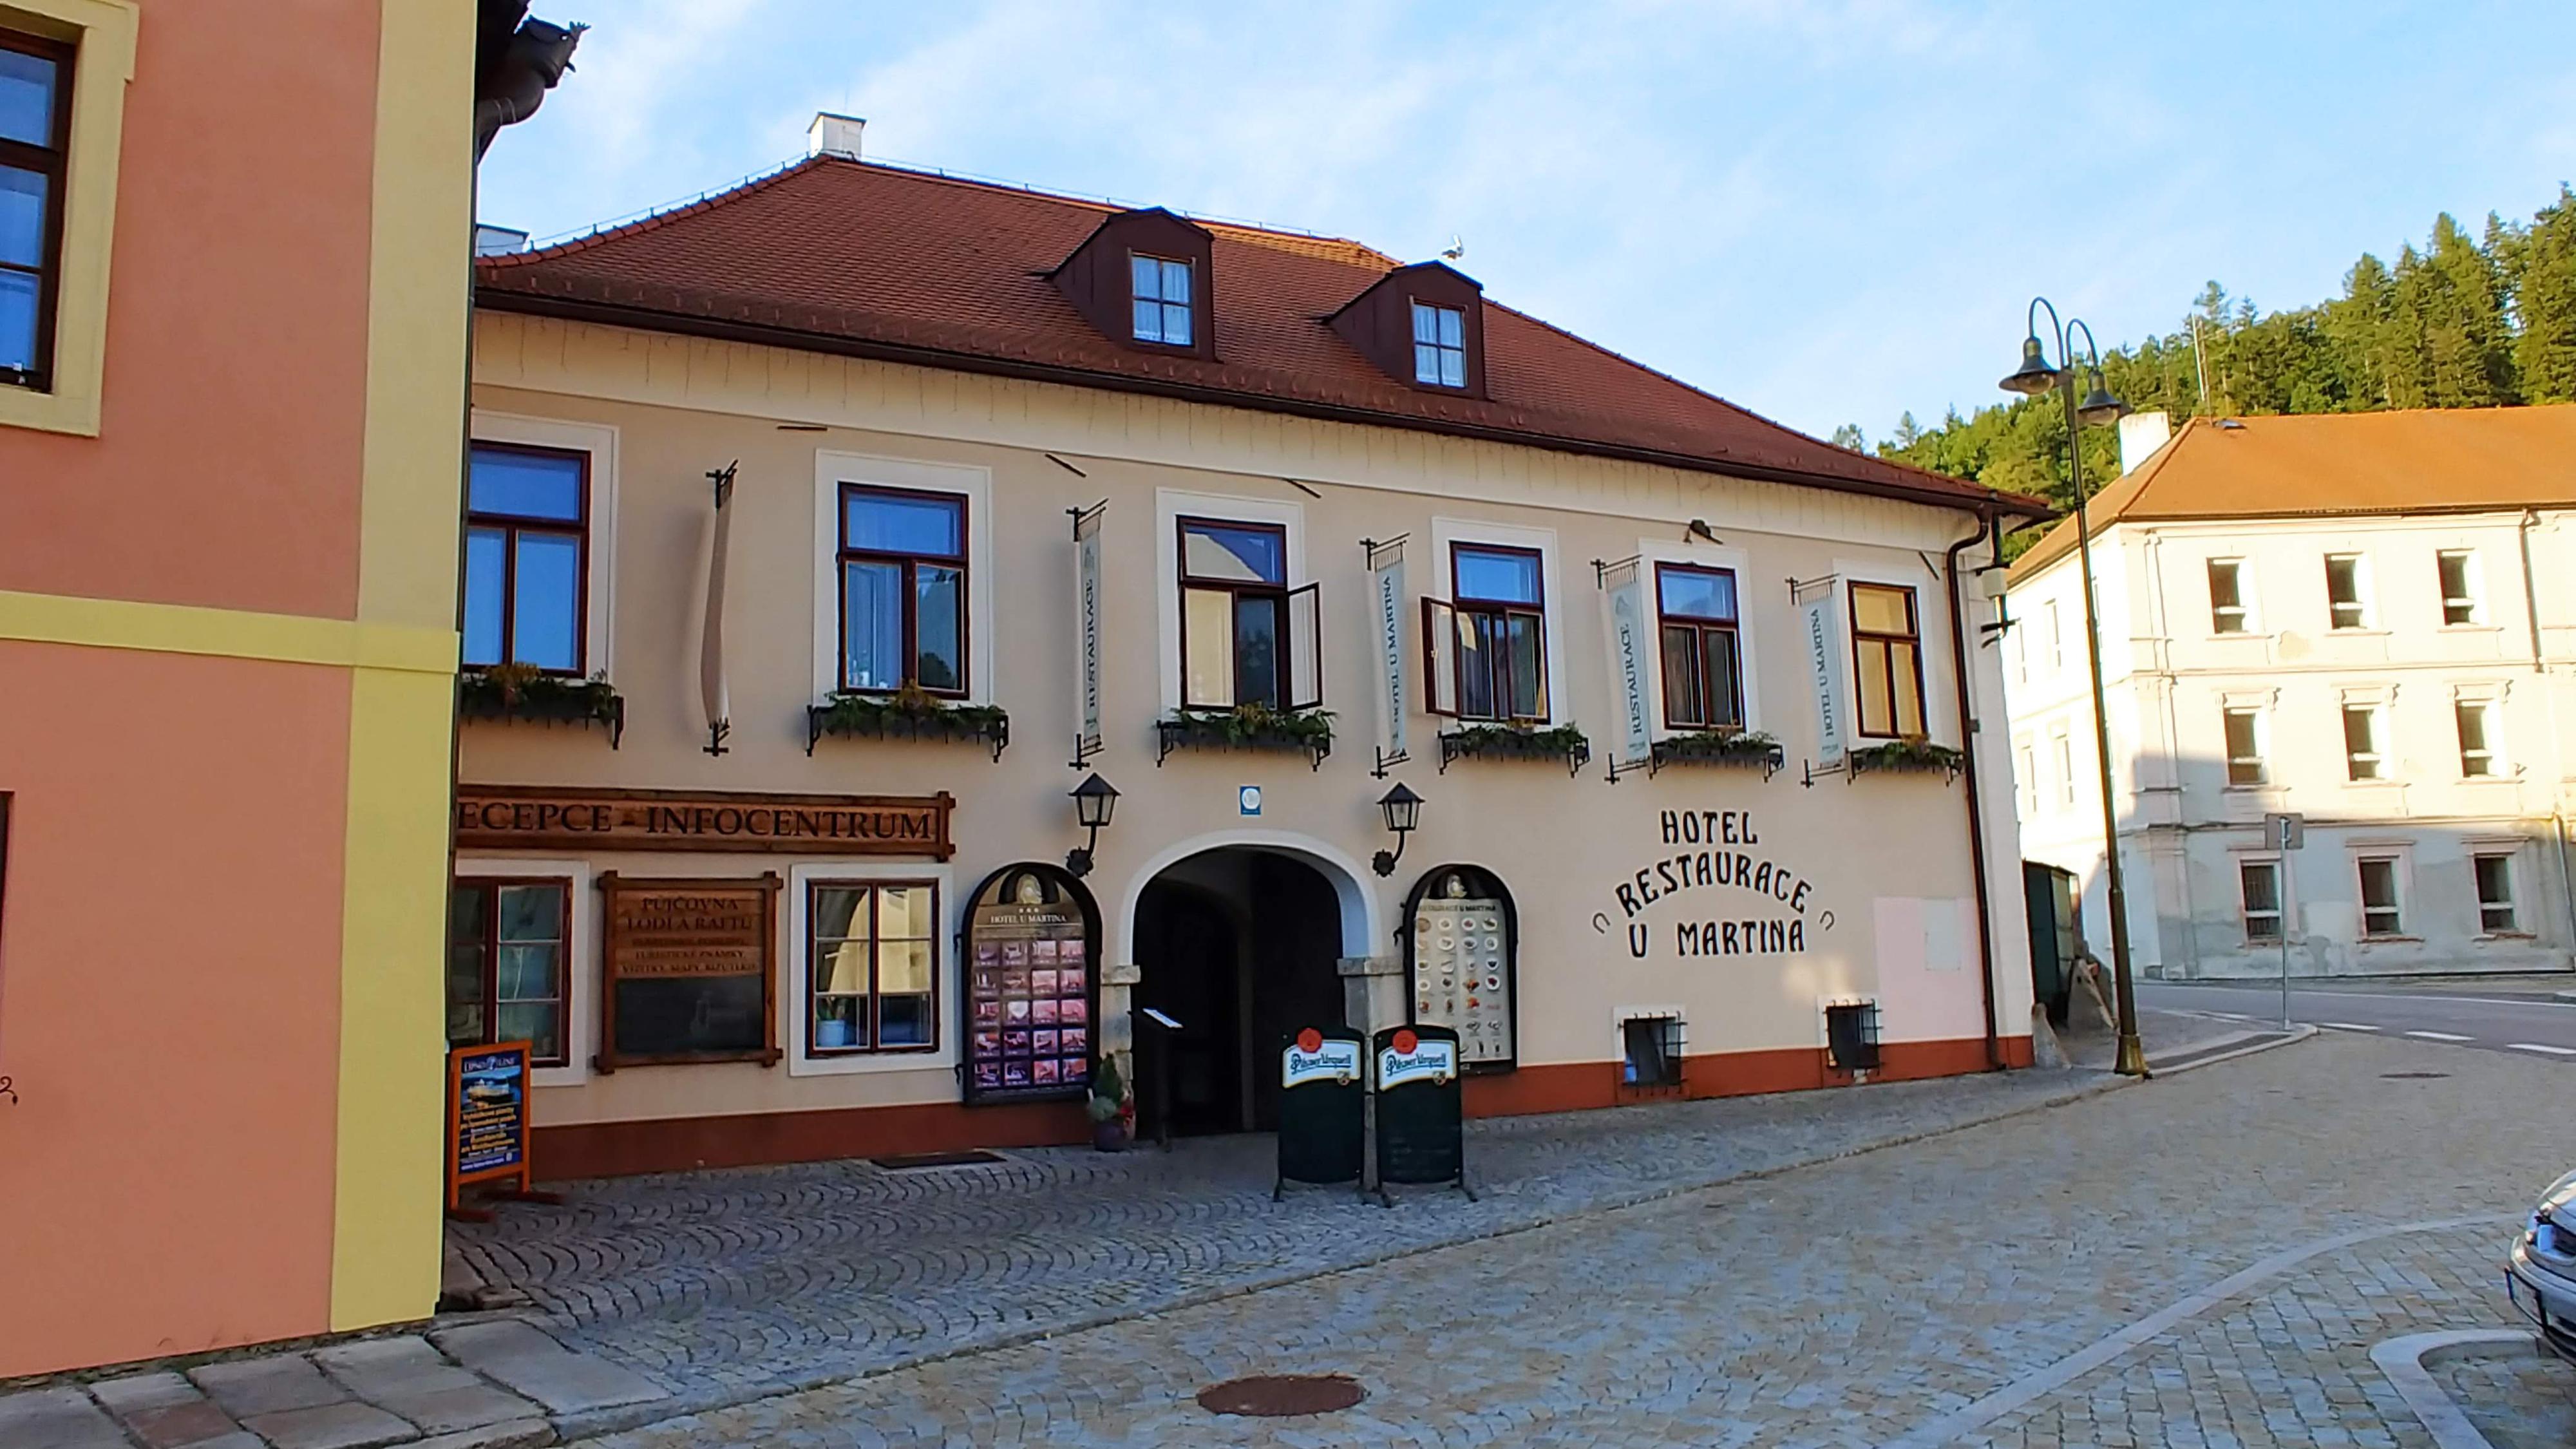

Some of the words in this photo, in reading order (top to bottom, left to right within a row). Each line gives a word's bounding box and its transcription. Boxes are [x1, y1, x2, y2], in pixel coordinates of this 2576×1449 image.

[1382, 575, 1397, 649] MARTINA
[1085, 579, 1096, 708] RESTAURACE
[1388, 654, 1398, 666] U
[1810, 609, 1826, 673] MARTINA
[1619, 623, 1643, 734] RESTAURACE
[1817, 676, 1828, 687] U
[1821, 690, 1834, 737] HOTEL
[458, 801, 612, 833] ECEPCE
[647, 806, 932, 840] INFOCENTRUM
[1660, 810, 1758, 844] HOTEL
[1615, 851, 1813, 918] RESTAURACE
[990, 915, 1018, 924] HOTEL
[1028, 914, 1067, 923] MARTINA
[1628, 923, 1647, 958] U
[1677, 920, 1805, 956] MARTINA
[1291, 1053, 1321, 1075] Pilsner
[1385, 1054, 1416, 1077] Pilsner
